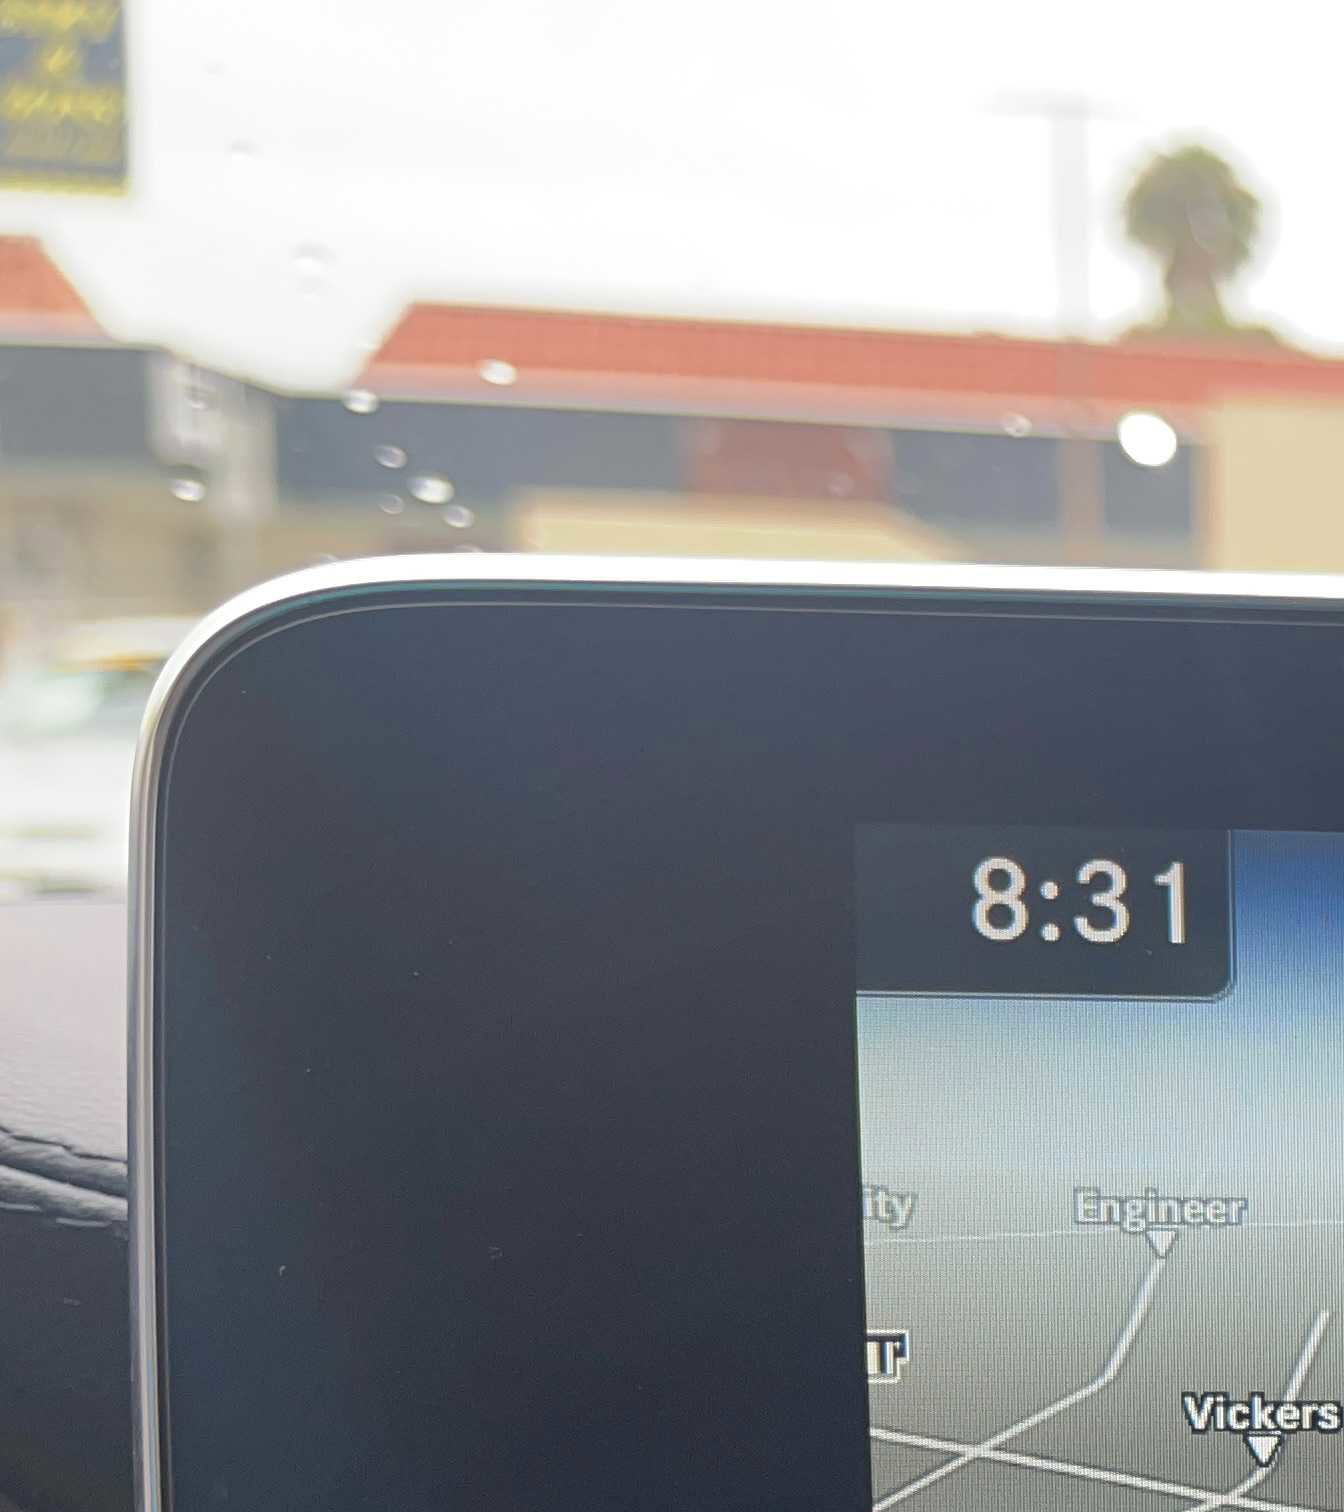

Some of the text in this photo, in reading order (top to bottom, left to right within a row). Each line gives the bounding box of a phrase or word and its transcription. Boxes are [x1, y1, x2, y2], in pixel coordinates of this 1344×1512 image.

[972, 855, 1188, 946] 8:31
[1075, 1189, 1246, 1231] Engineer
[1184, 1394, 1342, 1433] Vickers
